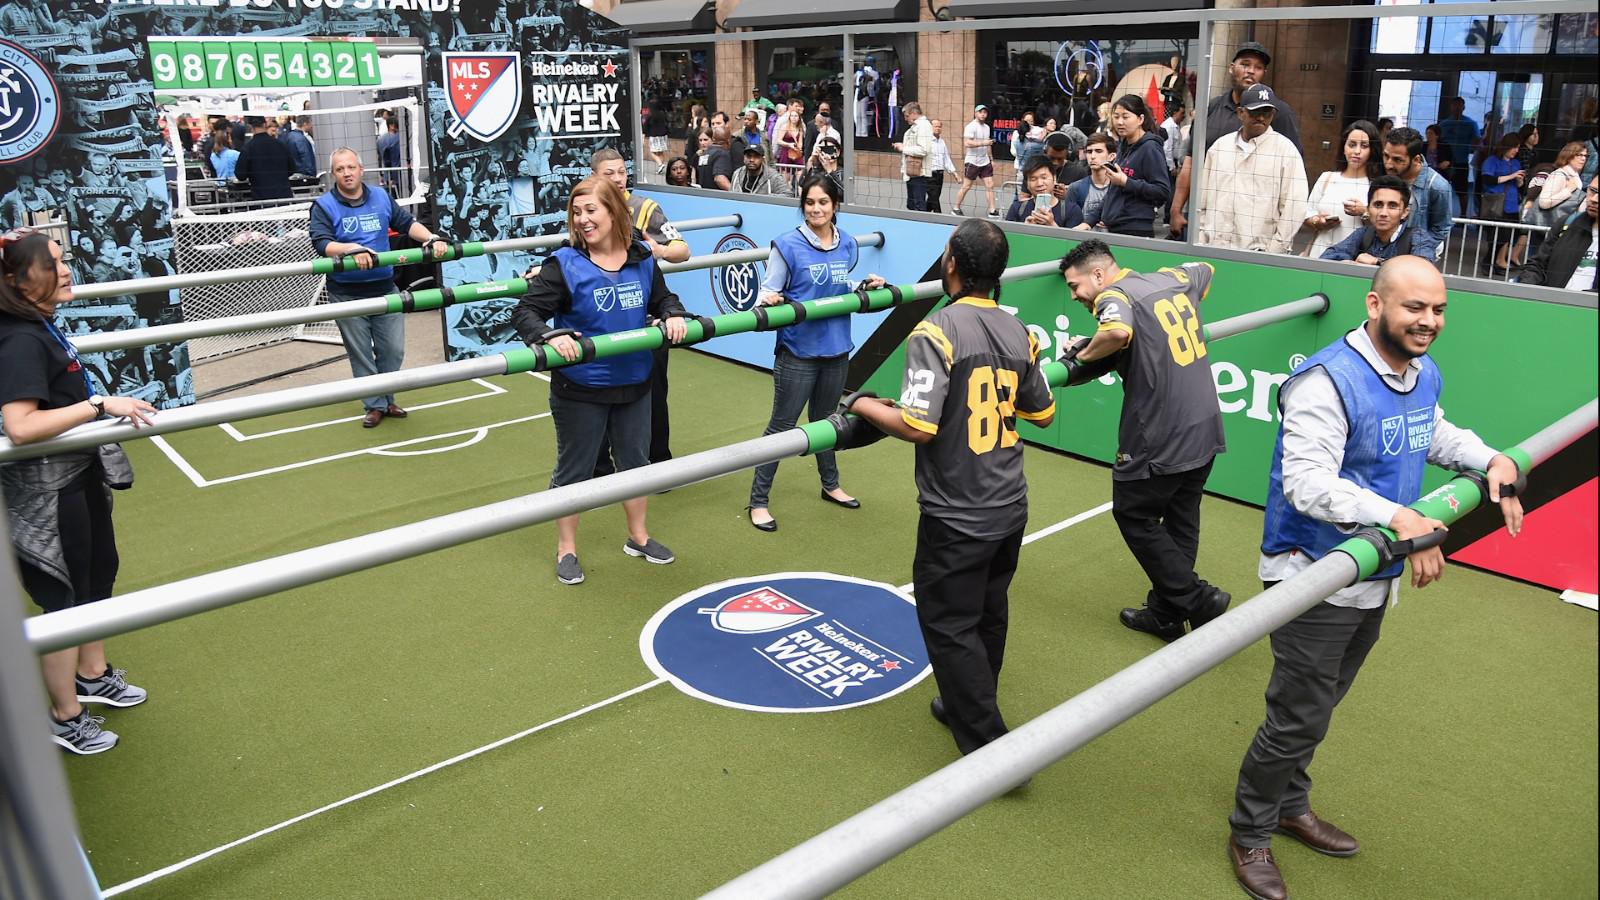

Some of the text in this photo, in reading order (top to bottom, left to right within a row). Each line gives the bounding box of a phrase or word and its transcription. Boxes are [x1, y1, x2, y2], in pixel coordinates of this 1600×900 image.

[3, 49, 30, 67] CITY
[532, 61, 599, 76] Heineken
[452, 61, 491, 80] MLS
[532, 83, 619, 104] RIVALRY
[534, 103, 621, 133] WEEK
[17, 131, 43, 152] CLUB
[832, 275, 848, 284] WEE
[620, 296, 644, 308] WEEK
[1154, 293, 1207, 367] 82
[967, 365, 1019, 456] 82
[1383, 420, 1397, 430] MLS
[752, 590, 790, 611] MLS
[814, 622, 880, 662] Heineken
[788, 629, 884, 682] RIVALRY
[764, 636, 864, 697] WEEK
